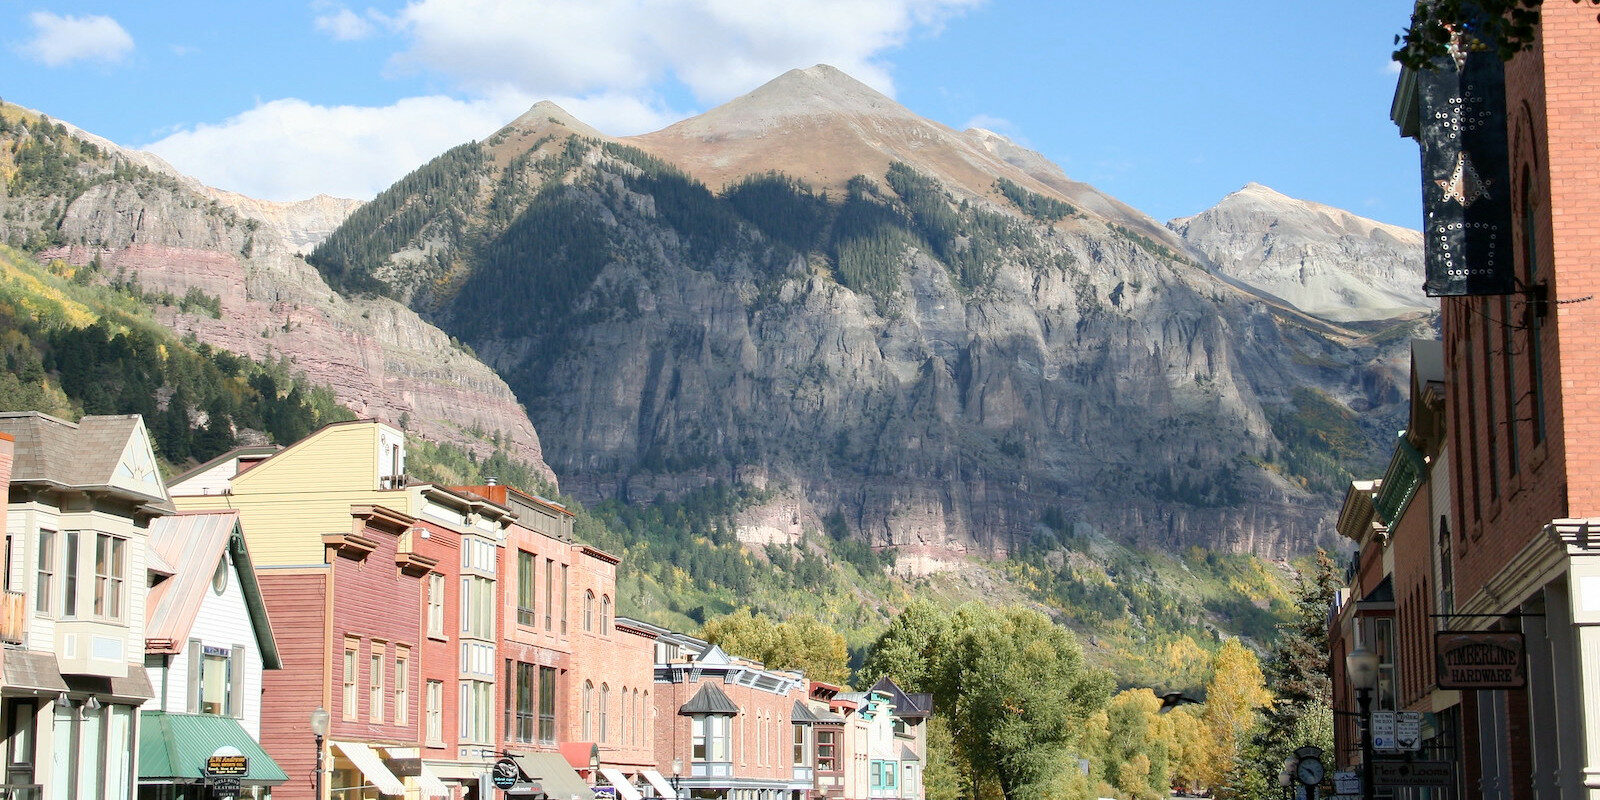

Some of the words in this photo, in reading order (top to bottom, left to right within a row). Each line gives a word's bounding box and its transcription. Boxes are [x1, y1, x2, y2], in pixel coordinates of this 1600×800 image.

[1445, 643, 1517, 666] TIMBERLINE
[1452, 669, 1512, 683] HARDWARE
[1374, 765, 1397, 776] Heir
[1412, 765, 1449, 776] Looms
